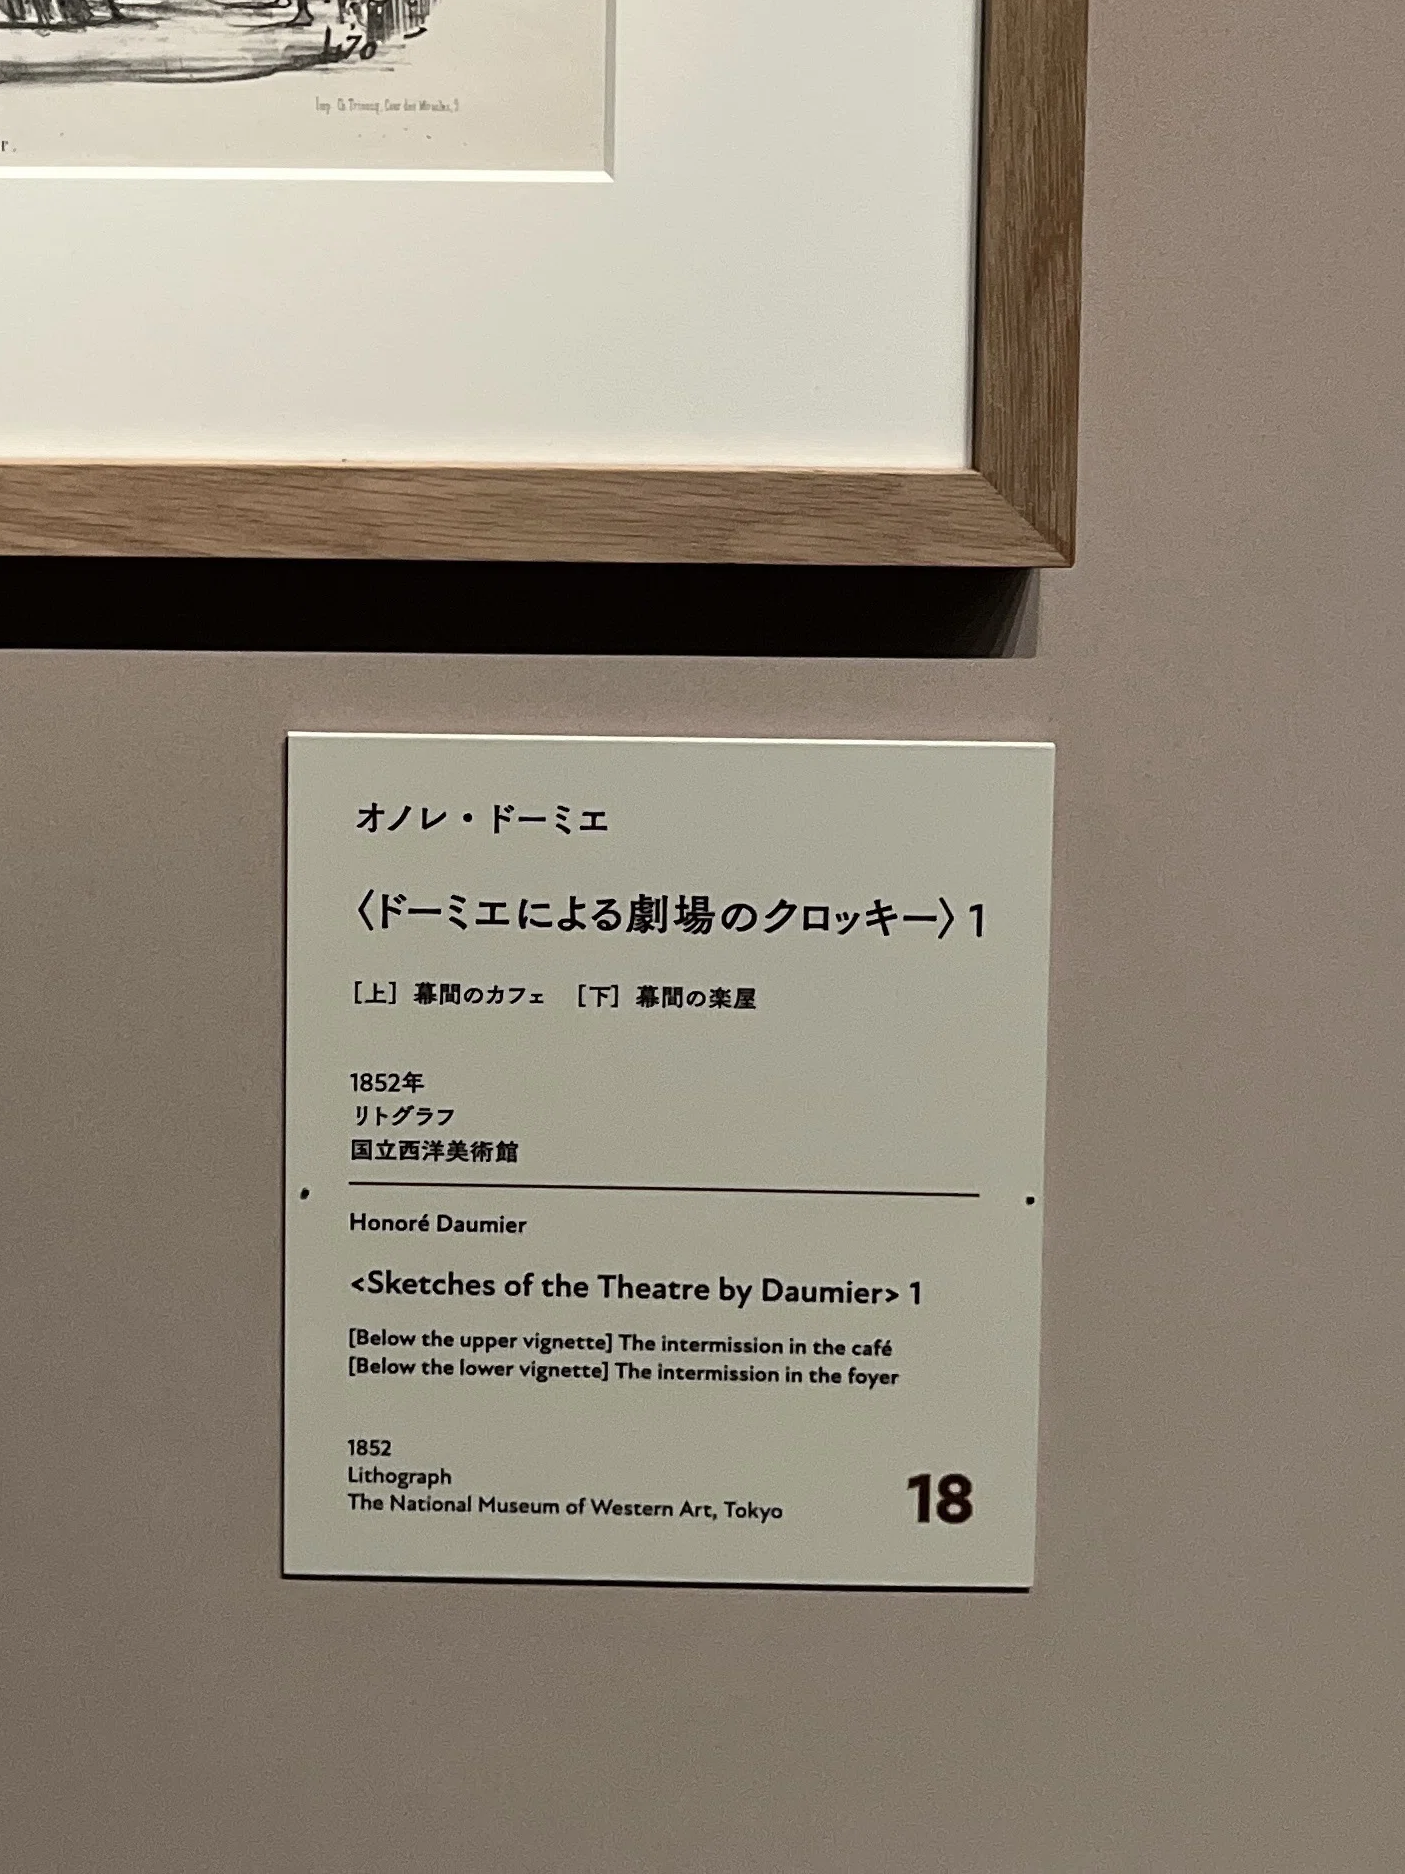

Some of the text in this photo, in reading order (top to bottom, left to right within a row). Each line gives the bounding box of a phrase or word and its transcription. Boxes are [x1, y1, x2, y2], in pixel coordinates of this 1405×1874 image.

[355, 801, 609, 835] オノレ・ドーミエ
[349, 1070, 426, 1094] 1852年
[356, 1104, 455, 1127] リトグラフ
[350, 1138, 519, 1164] 国立西洋美術館
[349, 1212, 528, 1234] Honoré Daumier
[350, 1269, 921, 1310] <Sketches of the Theatre by Daumier> 1
[348, 1327, 893, 1357] [Below the upper vignette] The intermission in the café
[348, 1356, 899, 1390] [Below the lower vignette] The intermission in the foyer
[347, 1438, 392, 1457] 1852
[347, 1465, 452, 1490] Lithograph
[347, 1492, 784, 1524] The National Museum of Western Art, Tokyo
[905, 1473, 974, 1525] 18
